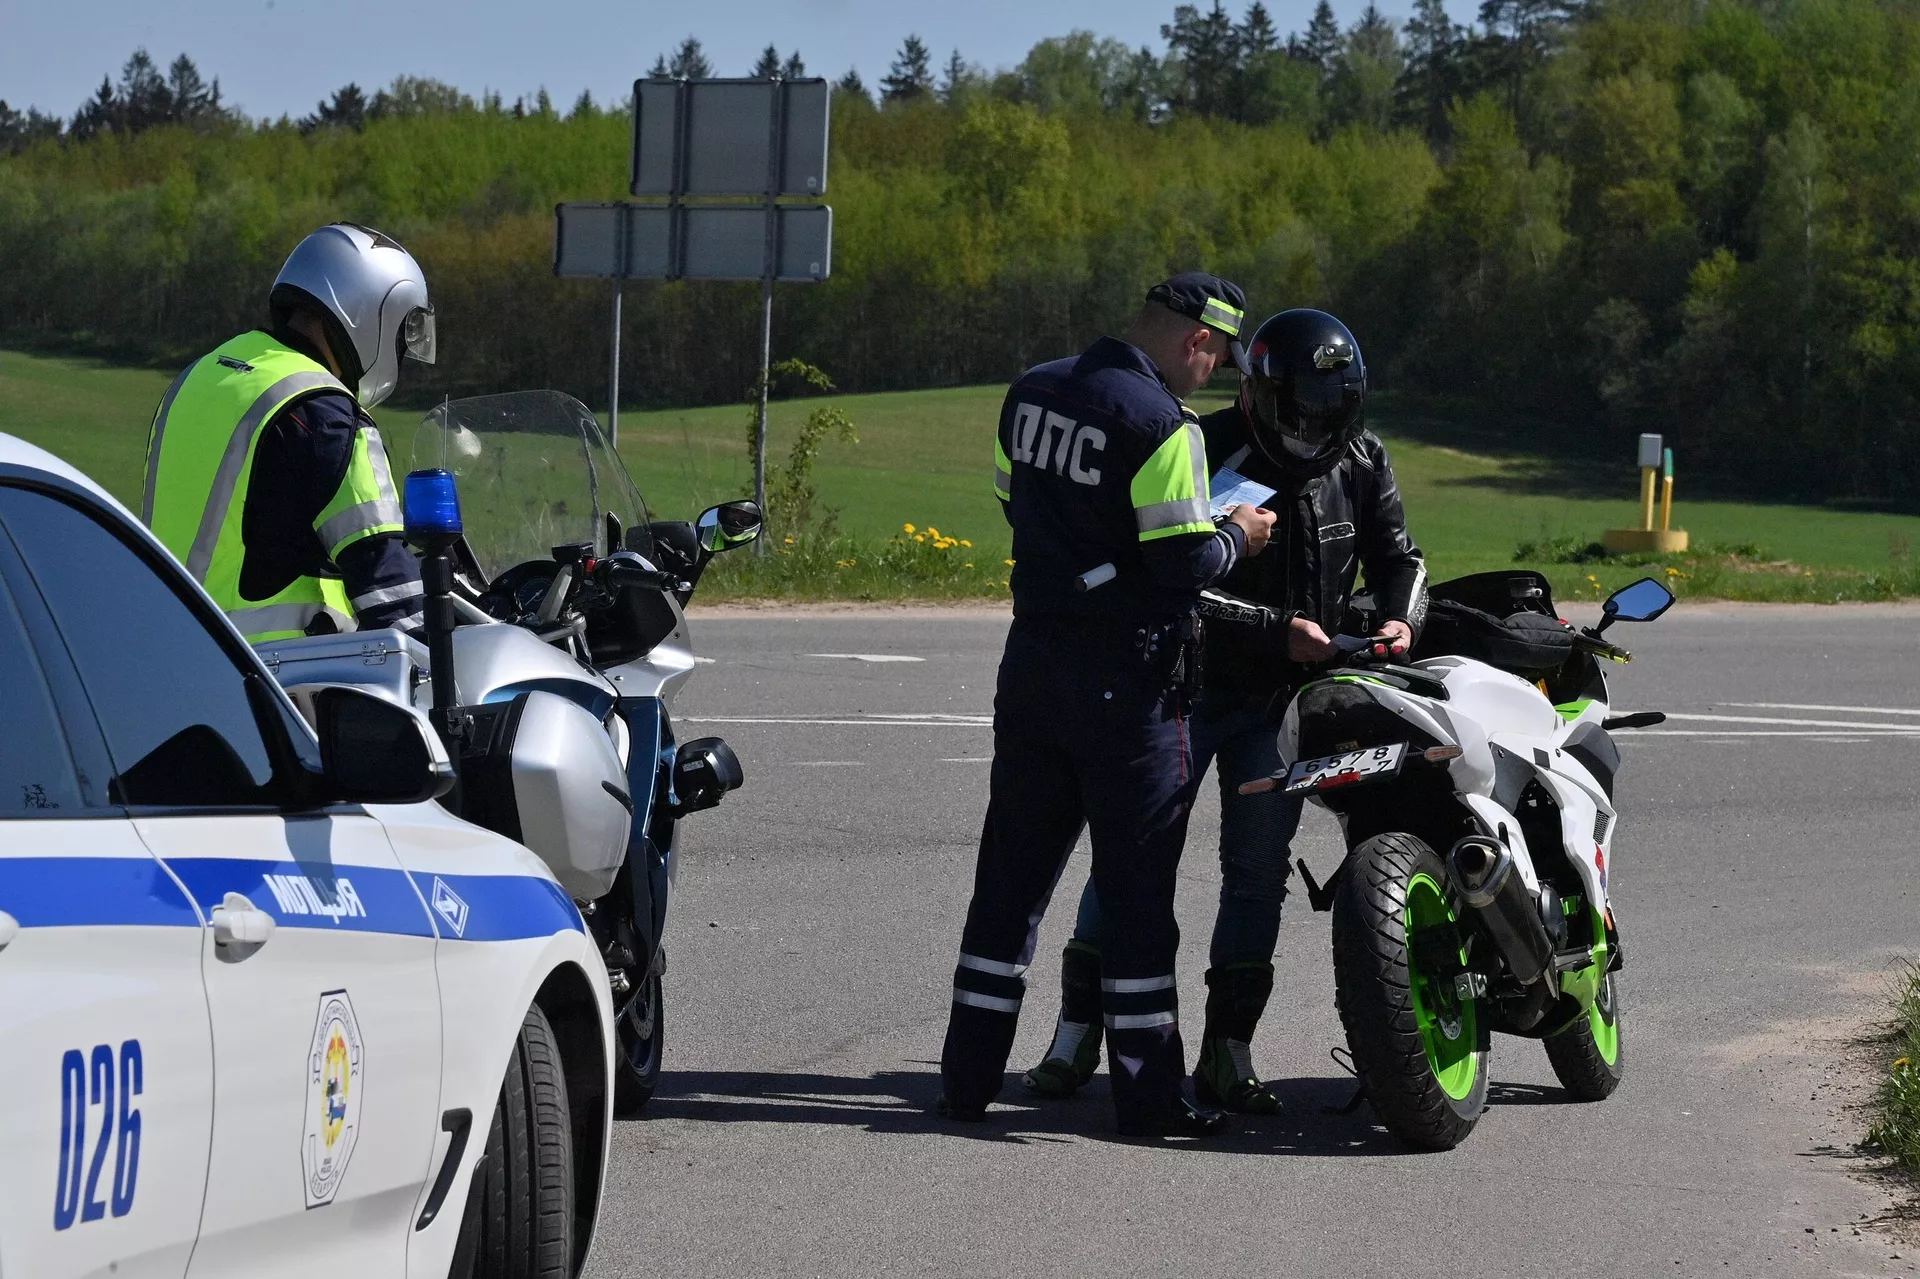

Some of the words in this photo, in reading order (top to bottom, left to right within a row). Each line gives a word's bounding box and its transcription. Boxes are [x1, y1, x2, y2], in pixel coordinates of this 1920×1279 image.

[1012, 402, 1107, 486] ДПС
[1304, 746, 1390, 773] 6578
[54, 1039, 143, 1231] 026
